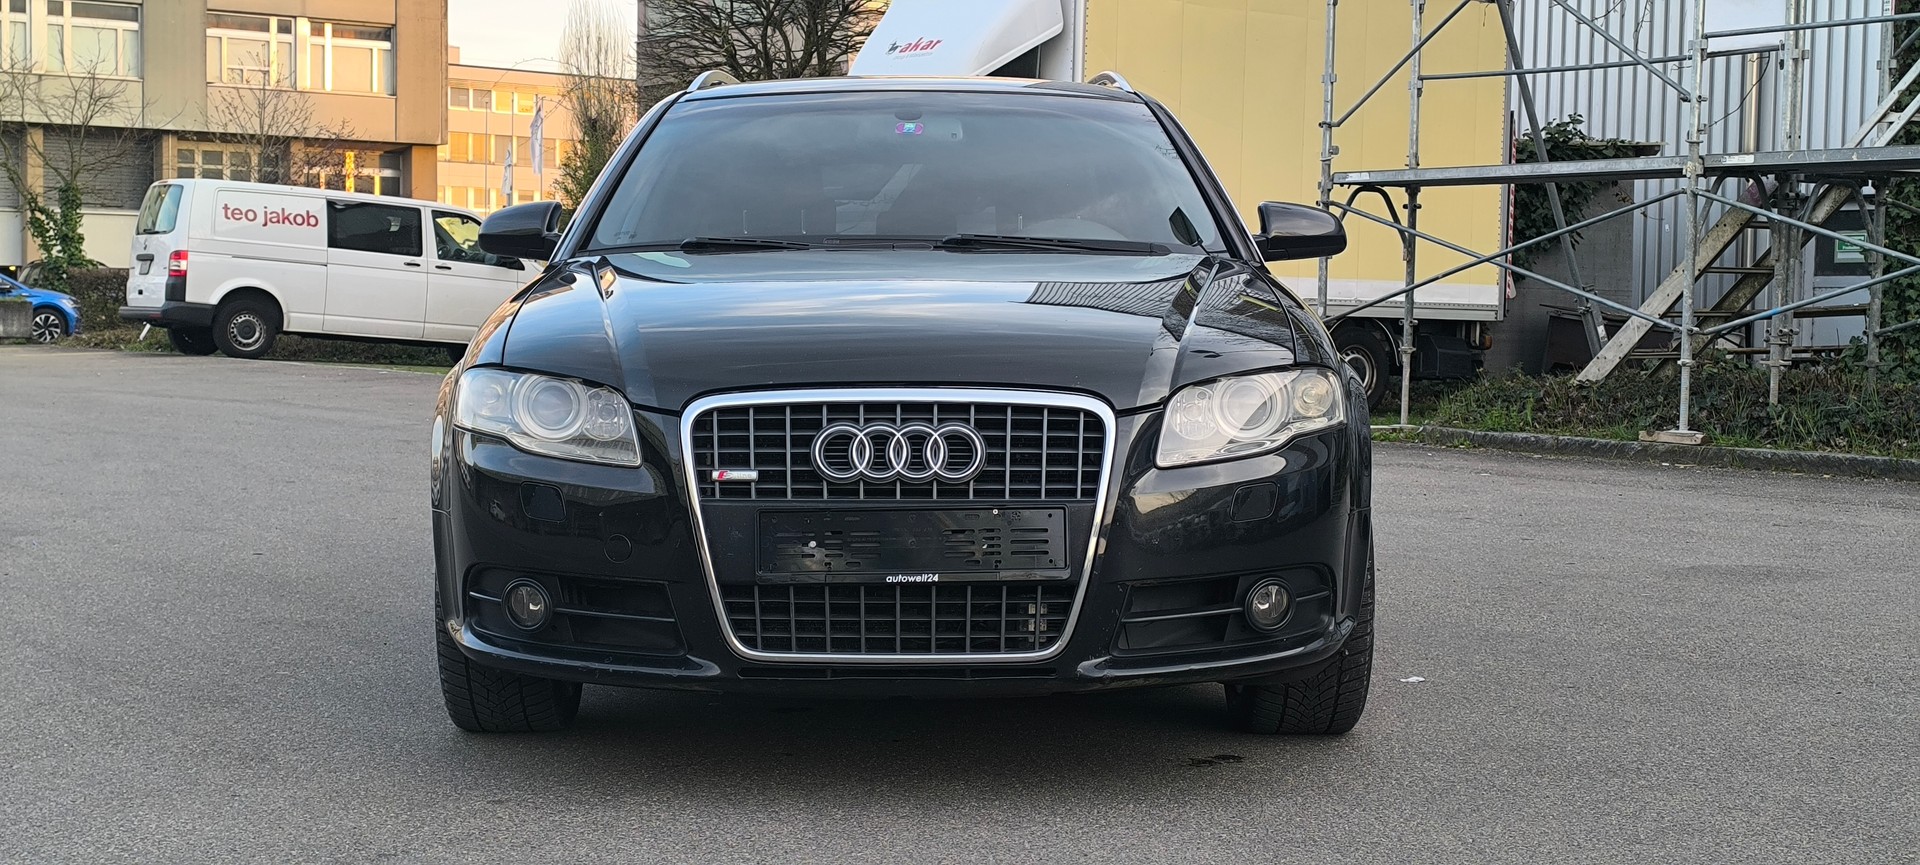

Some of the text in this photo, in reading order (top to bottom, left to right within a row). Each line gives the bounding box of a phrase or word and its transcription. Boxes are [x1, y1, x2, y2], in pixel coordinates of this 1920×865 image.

[898, 36, 943, 54] akar
[222, 203, 319, 228] teo jakob
[886, 573, 939, 583] autowelt24
